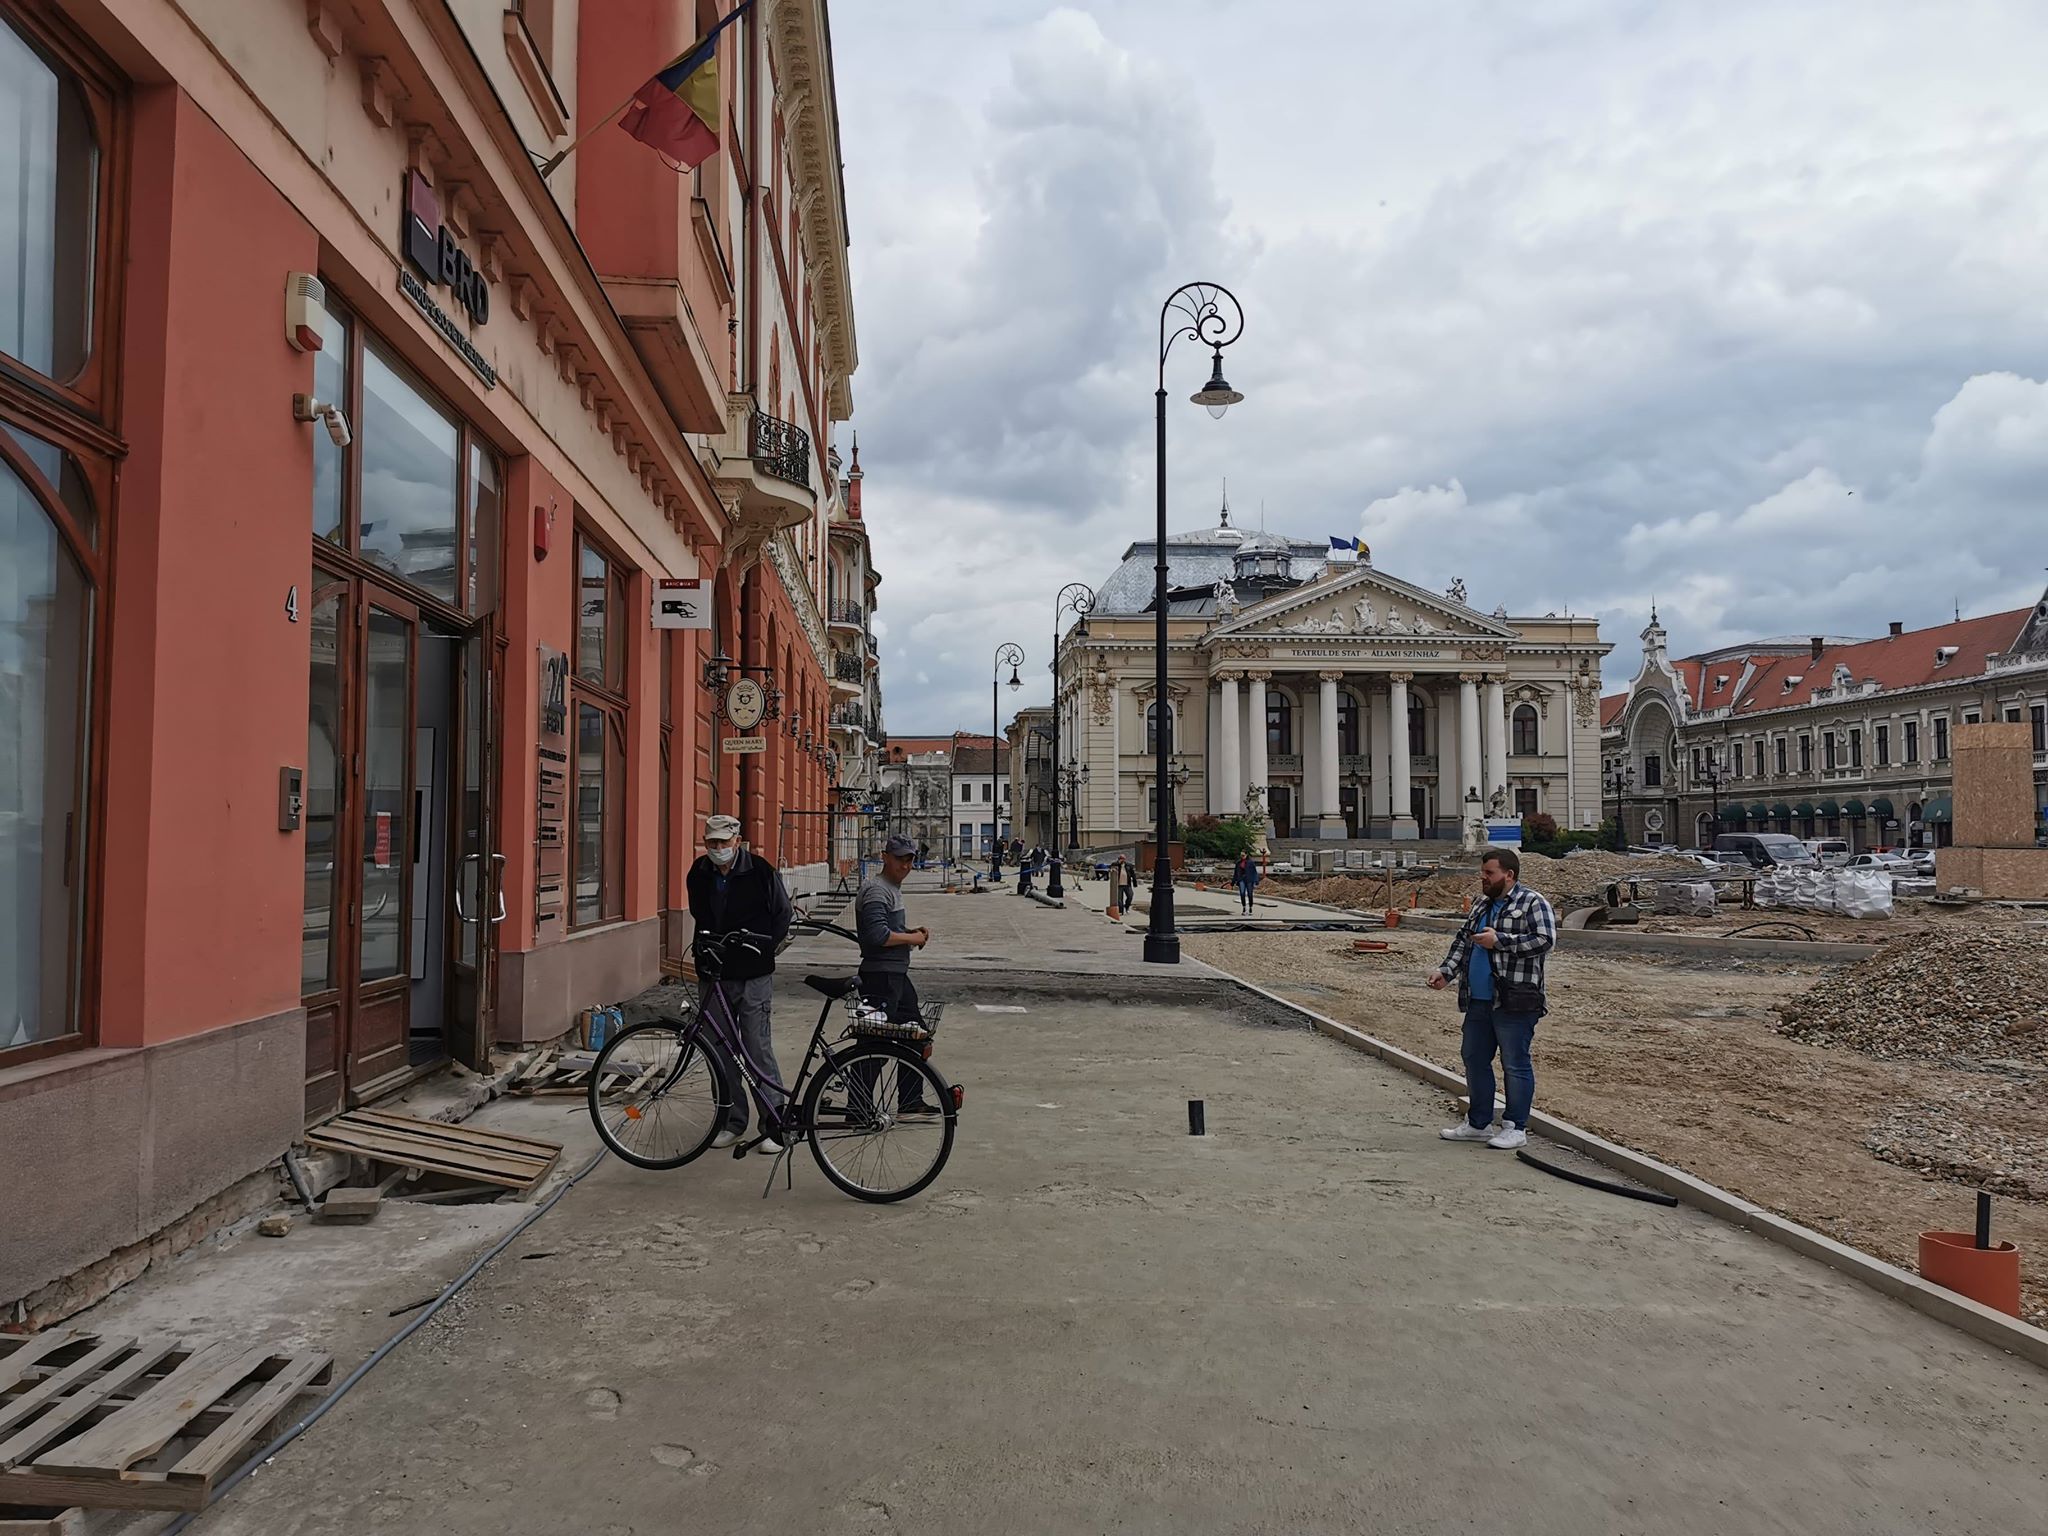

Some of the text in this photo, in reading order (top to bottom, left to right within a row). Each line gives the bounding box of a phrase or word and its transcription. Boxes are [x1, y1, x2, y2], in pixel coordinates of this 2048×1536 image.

[439, 225, 489, 325] BRD
[285, 585, 298, 622] 4
[1291, 649, 1327, 657] TEATRUL
